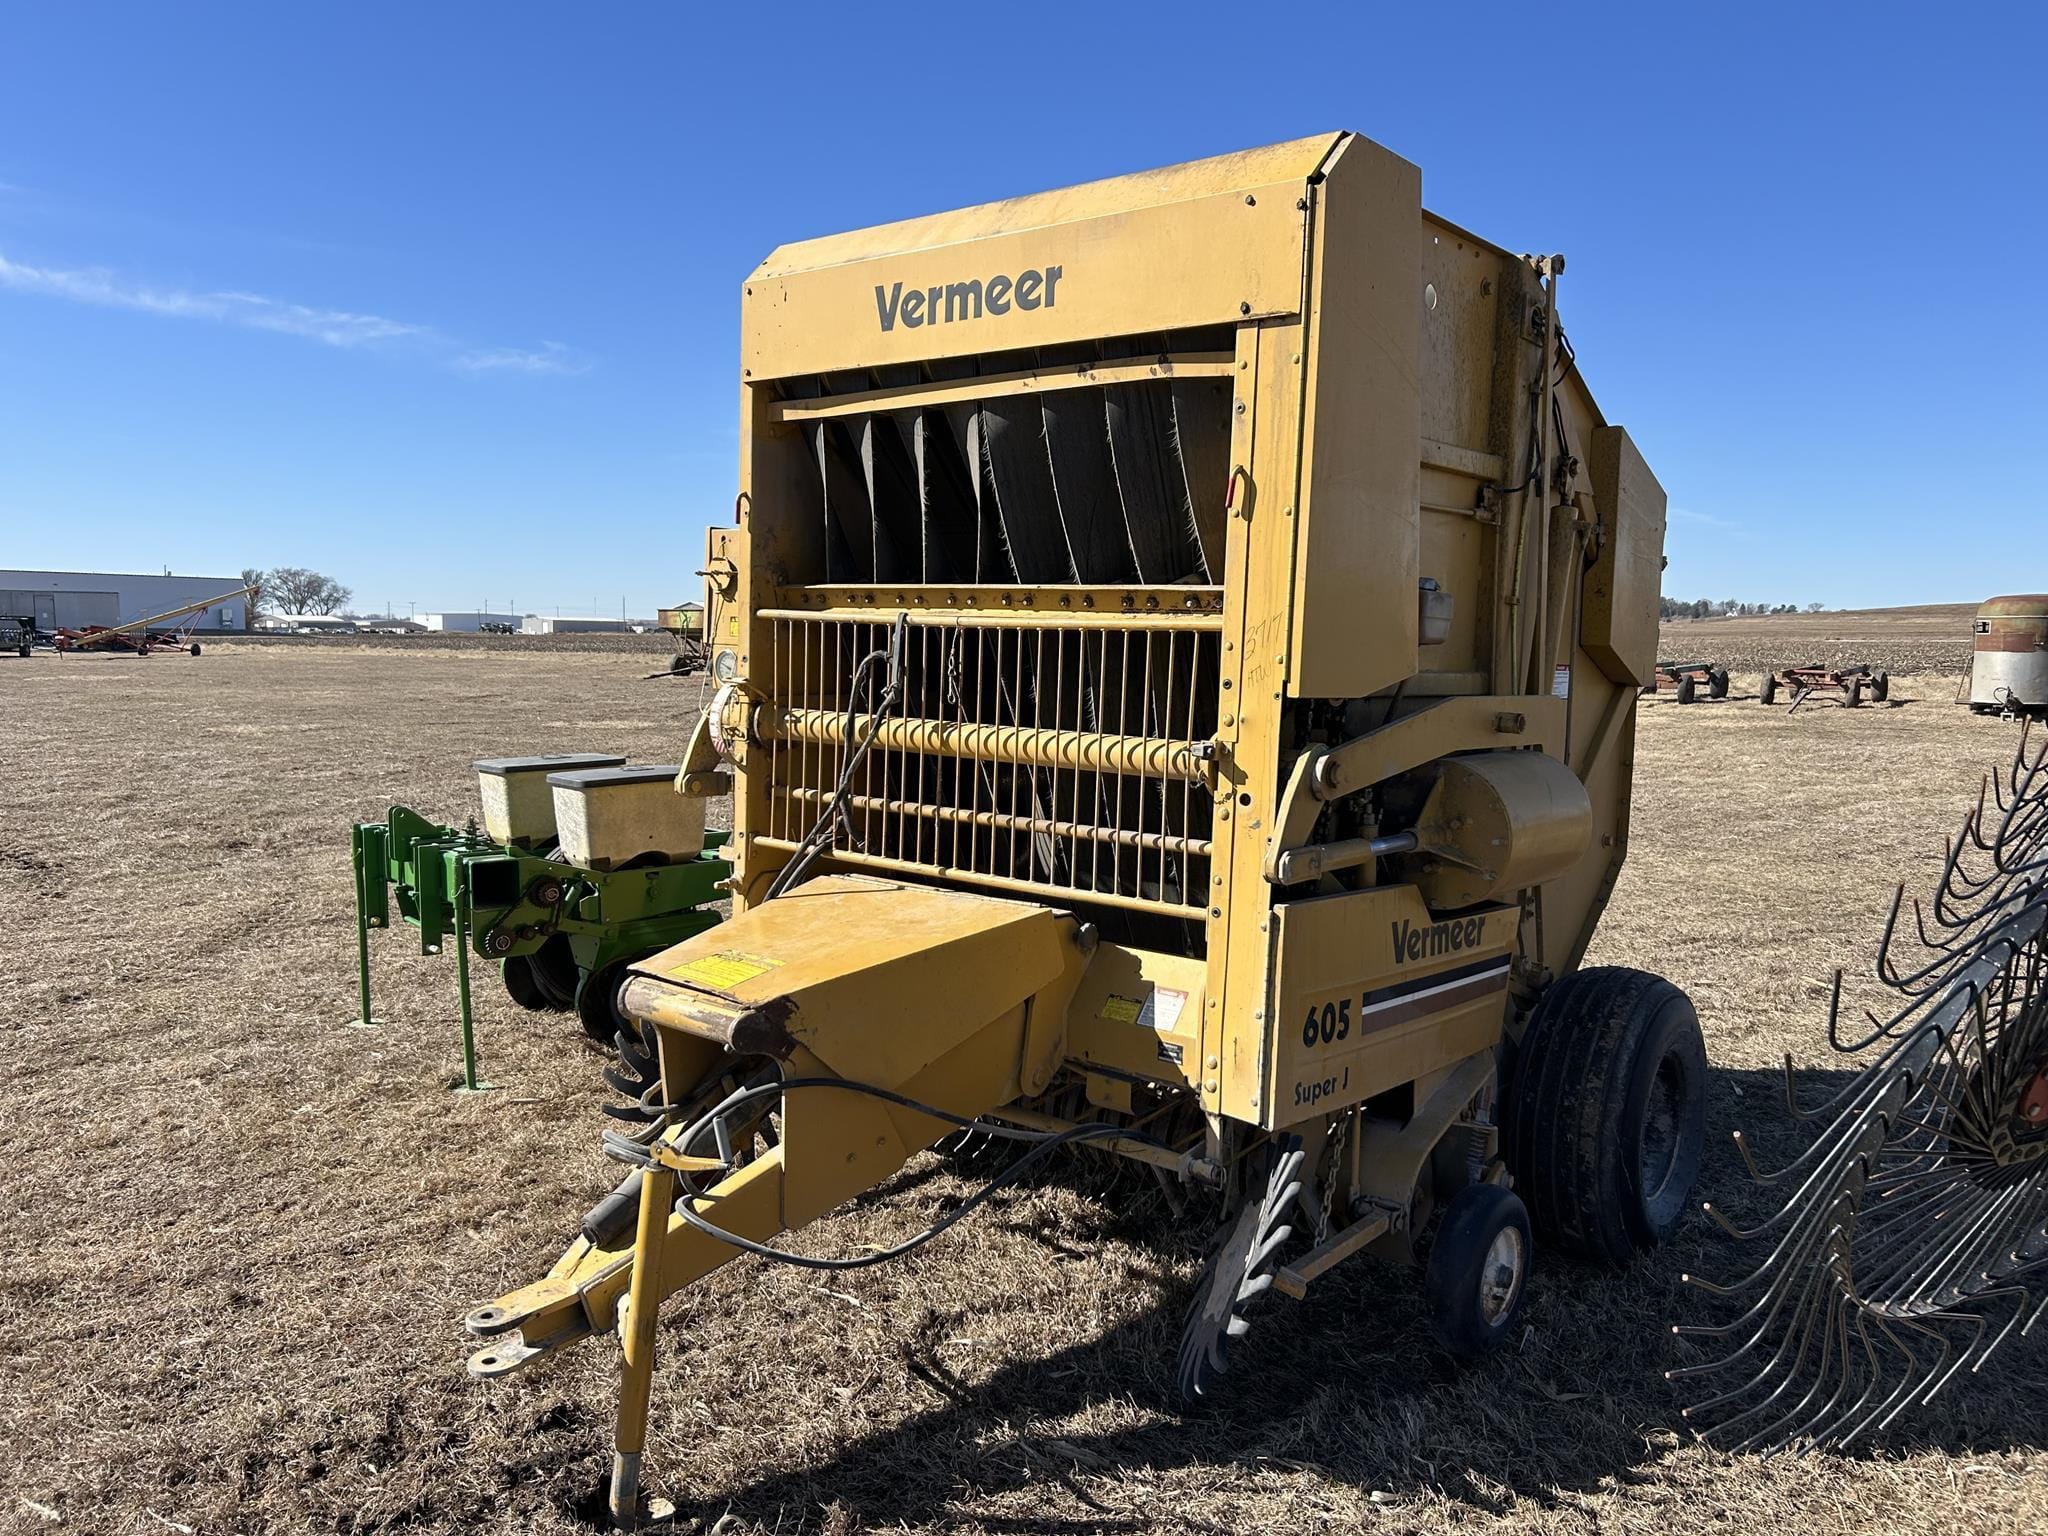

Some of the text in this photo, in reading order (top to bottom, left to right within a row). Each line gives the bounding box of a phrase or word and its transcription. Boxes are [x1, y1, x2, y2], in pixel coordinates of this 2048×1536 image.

[874, 265, 1063, 332] Vermeer
[1391, 915, 1486, 964] Vermeer
[1302, 999, 1352, 1048] 605
[1294, 1067, 1349, 1106] Super J
